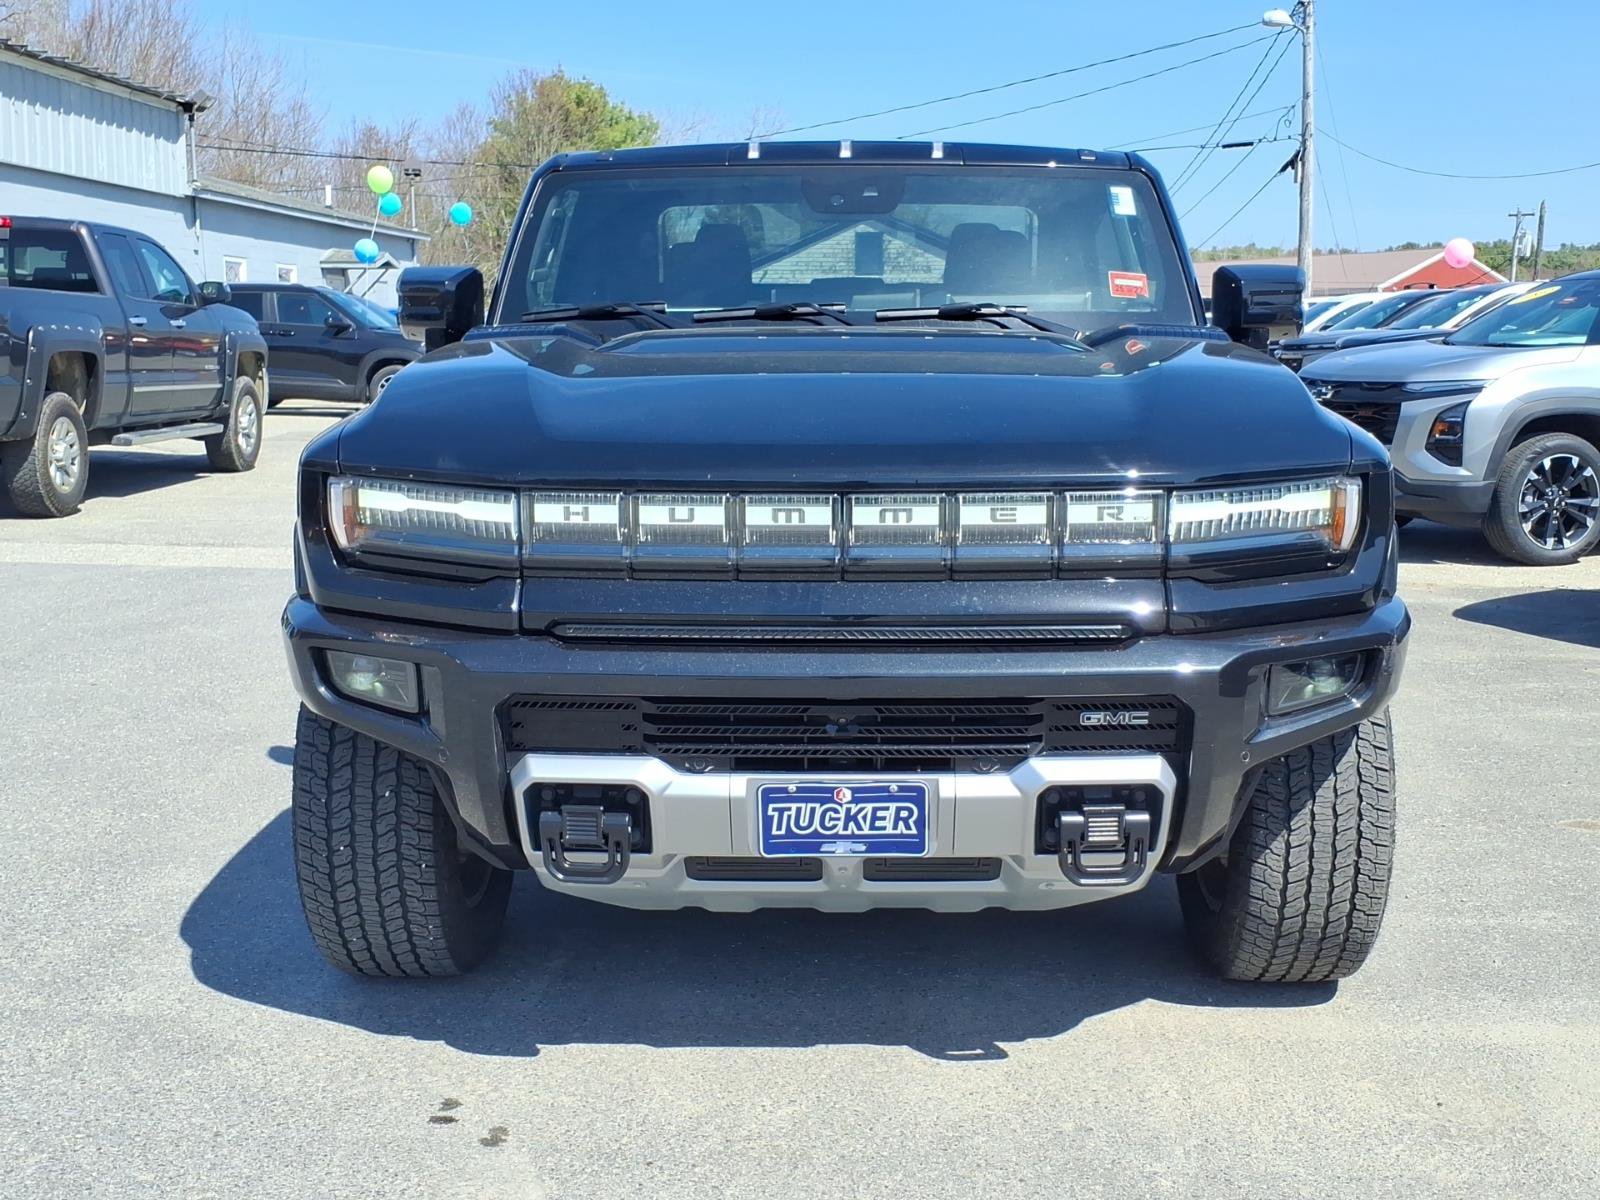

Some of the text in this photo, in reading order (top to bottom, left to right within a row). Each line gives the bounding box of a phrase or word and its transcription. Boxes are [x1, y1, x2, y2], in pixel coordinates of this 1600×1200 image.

[563, 505, 1124, 524] HUMMER
[1080, 711, 1149, 725] GMC
[767, 803, 918, 835] TUCKER
